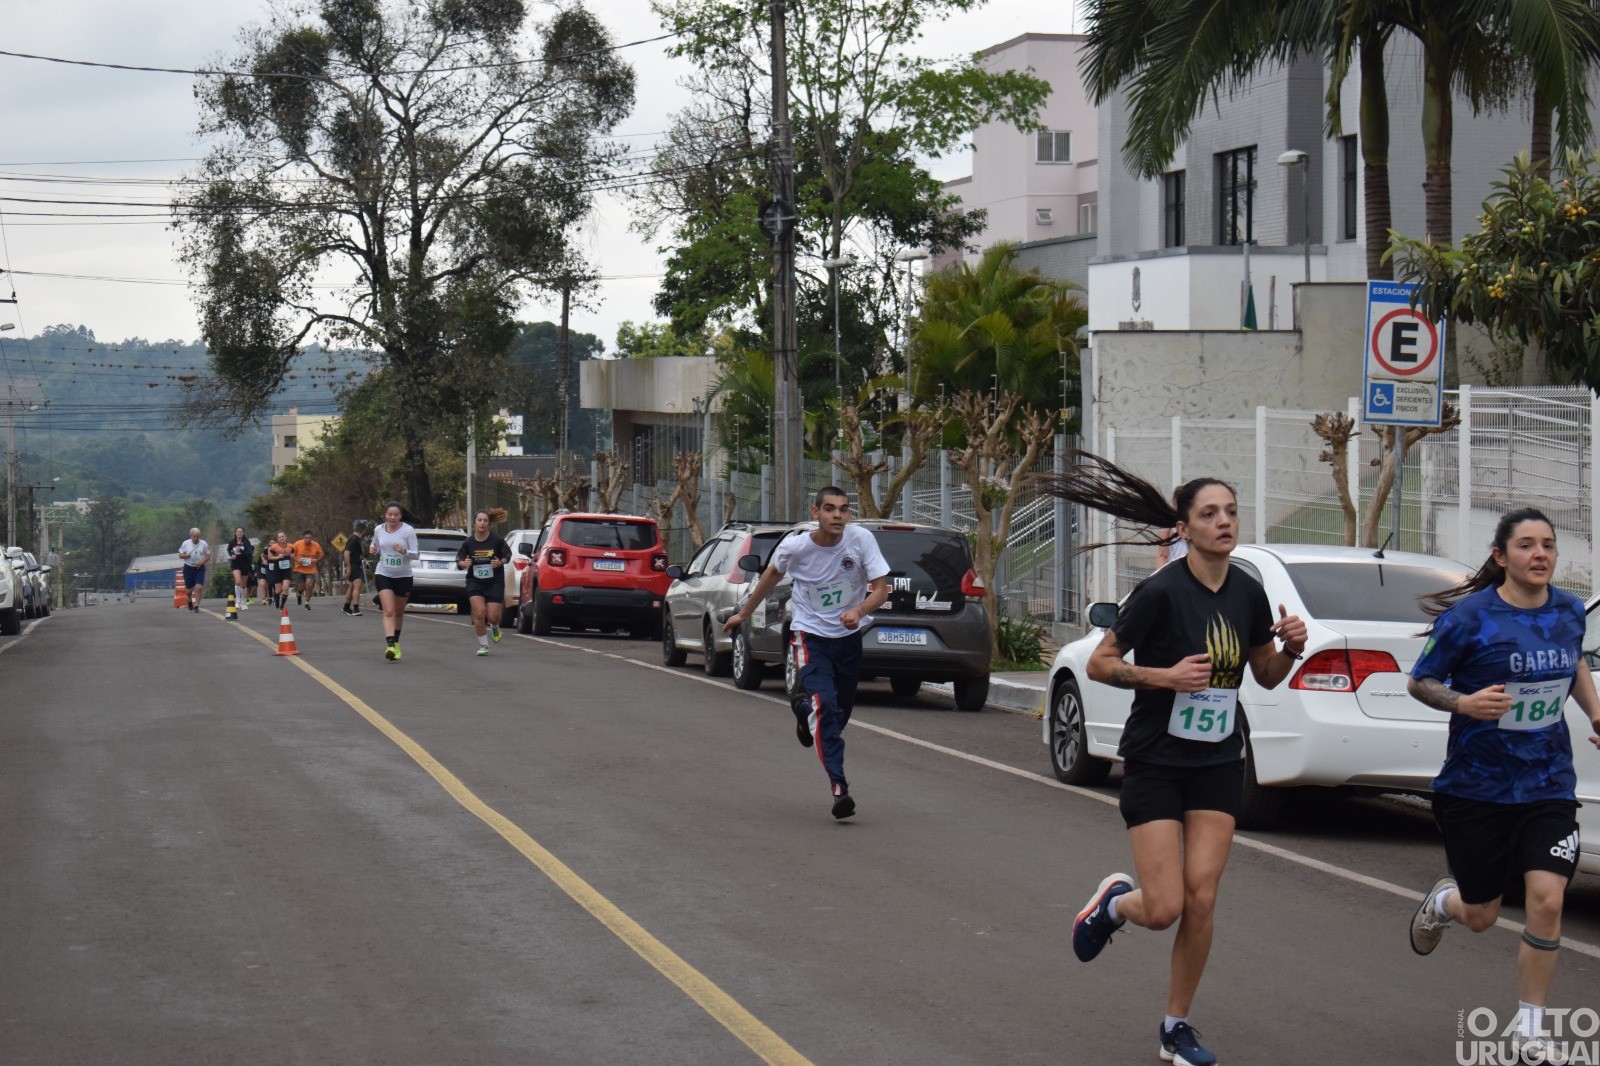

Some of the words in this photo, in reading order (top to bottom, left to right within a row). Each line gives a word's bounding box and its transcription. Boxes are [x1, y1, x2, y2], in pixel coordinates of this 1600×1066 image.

[1390, 321, 1419, 363] E
[1396, 386, 1429, 395] EXCLUSIVO
[1396, 396, 1433, 404] DEFICIENTES
[385, 558, 402, 566] 188
[477, 569, 489, 577] 92
[893, 577, 911, 592] FIAT
[821, 590, 843, 607] 27
[1519, 687, 1540, 695] Sesc
[1190, 693, 1211, 702] Sesc
[1510, 696, 1561, 722] 184
[1179, 706, 1228, 734] 151
